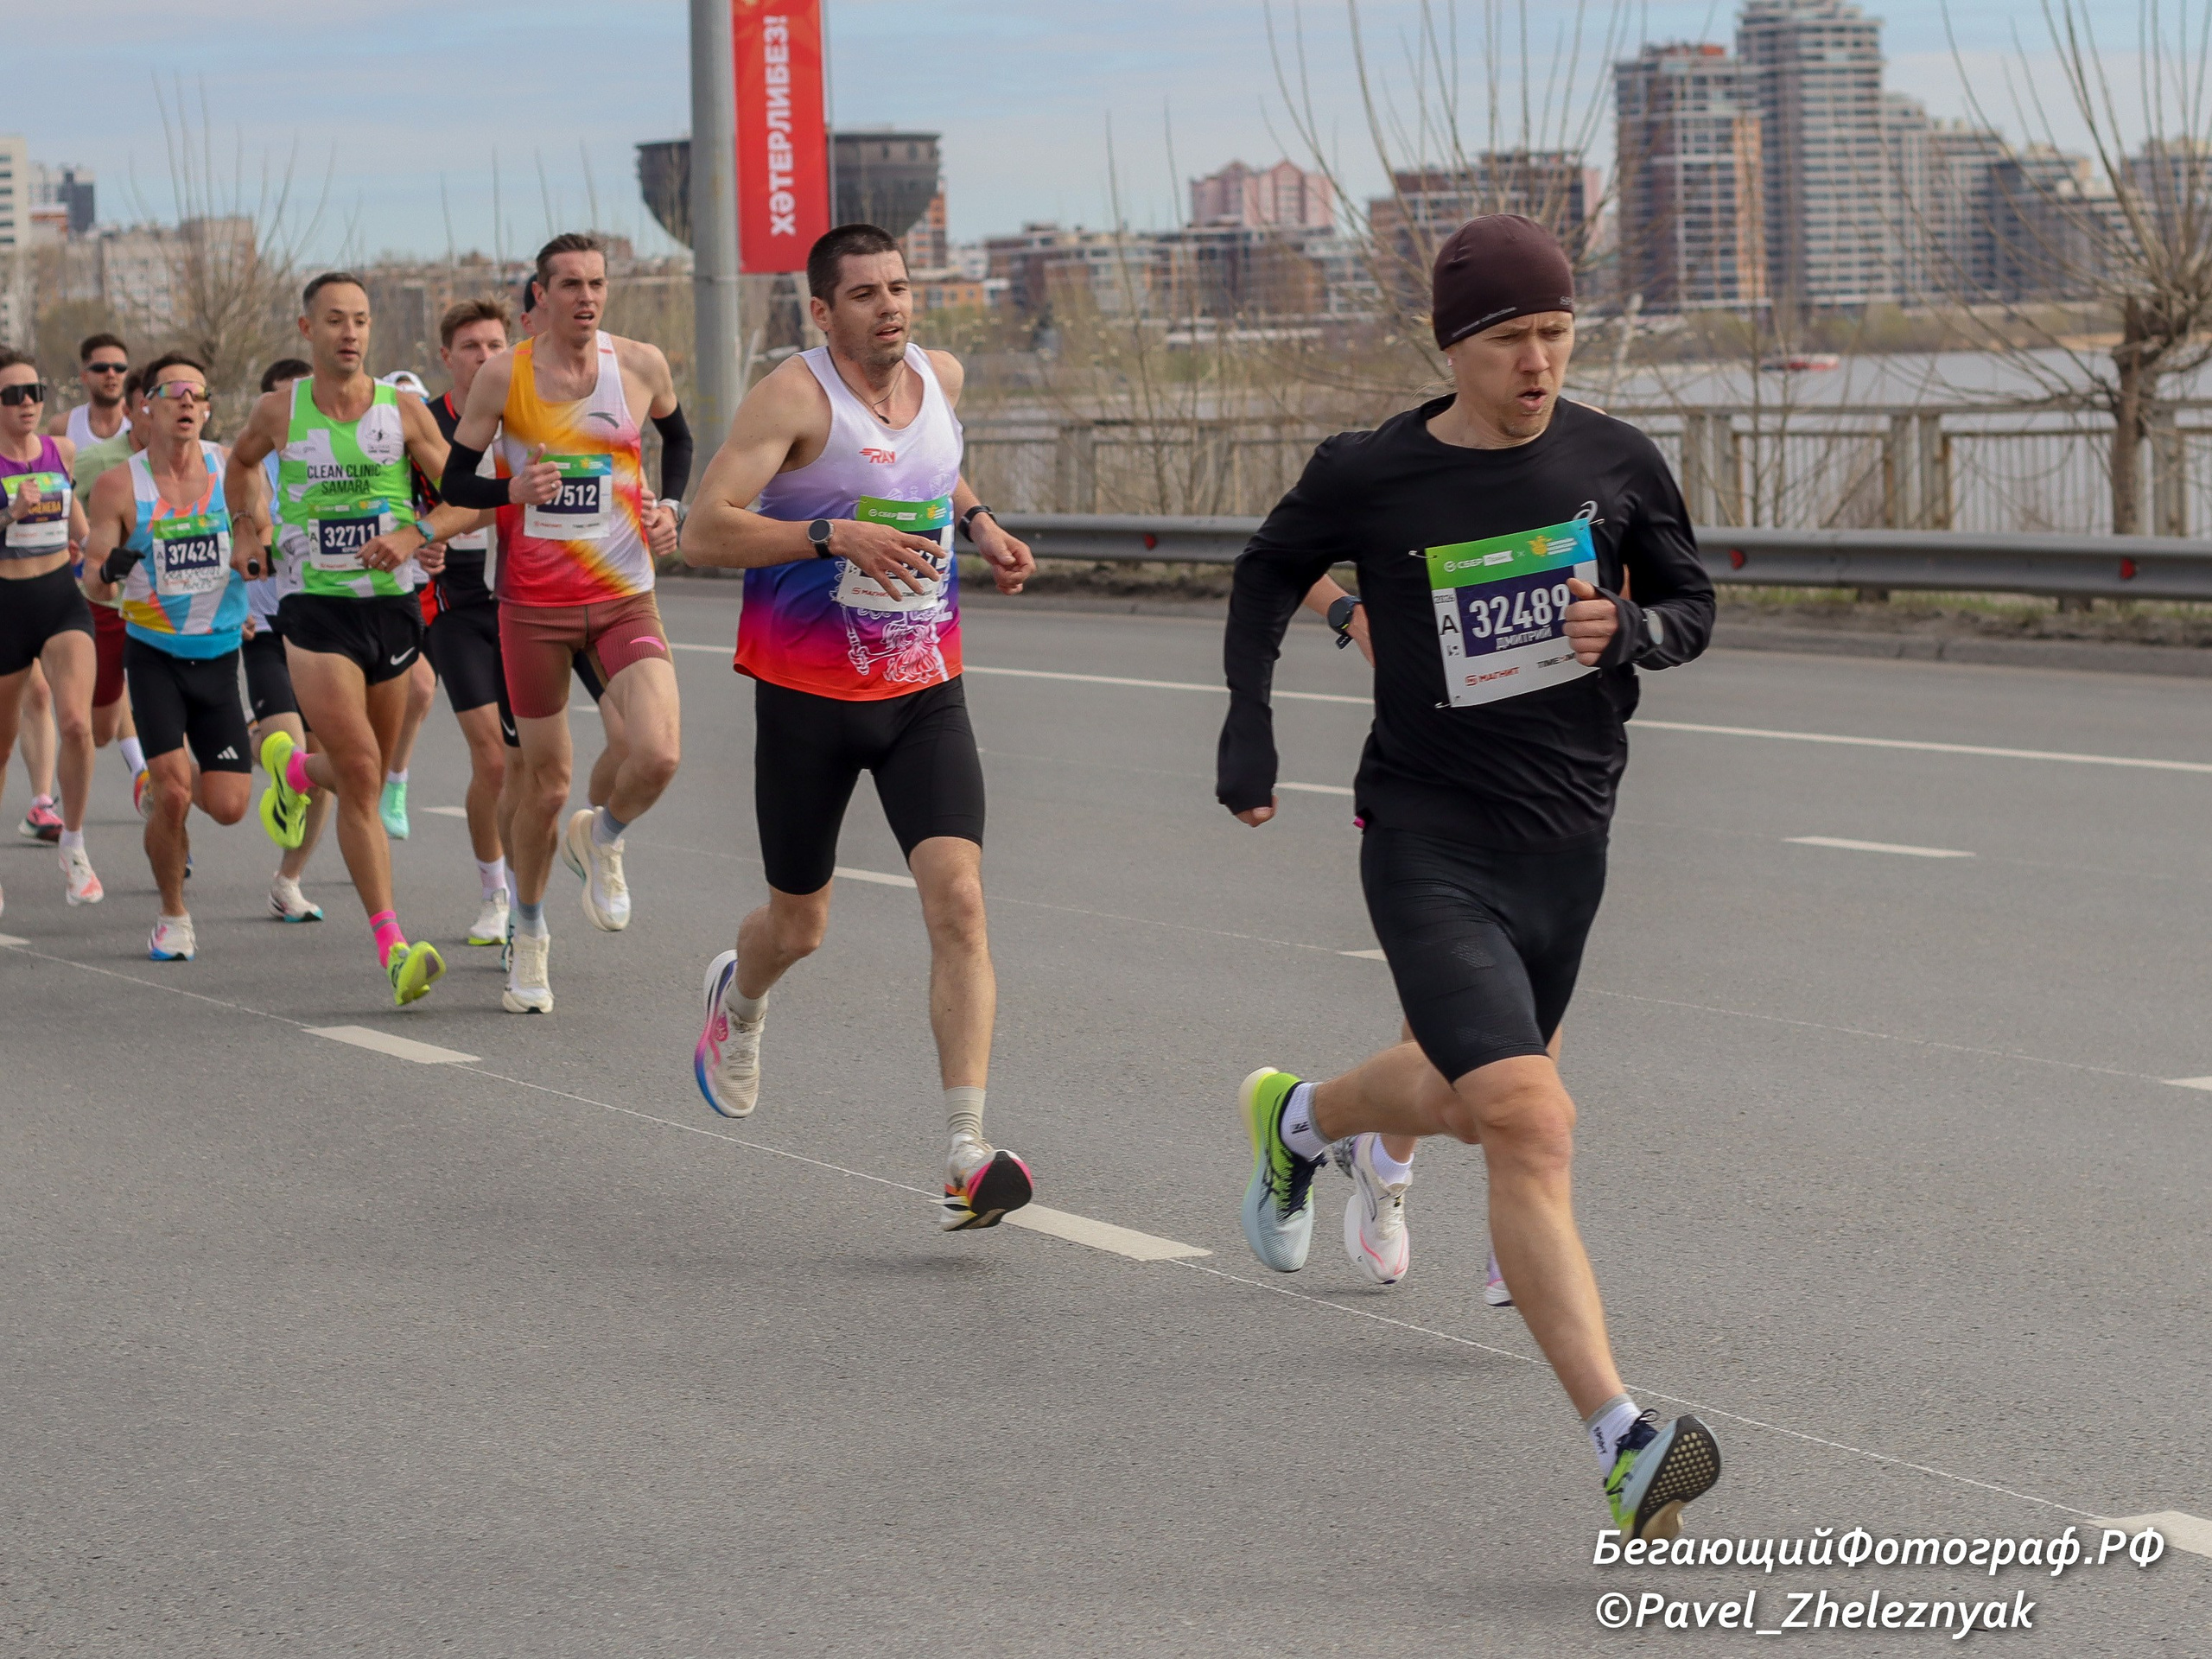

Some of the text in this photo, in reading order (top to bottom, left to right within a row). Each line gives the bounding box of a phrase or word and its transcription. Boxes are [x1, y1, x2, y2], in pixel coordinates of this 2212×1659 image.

[308, 464, 381, 479] CLEAN CLINIC
[321, 479, 370, 495] SAMARA
[545, 484, 597, 507] 7512
[324, 523, 375, 548] 32711
[168, 539, 218, 566] 37424
[1469, 582, 1571, 639] 32489
[1439, 614, 1459, 636] A
[1496, 624, 1553, 651] ДМИТРИЙ
